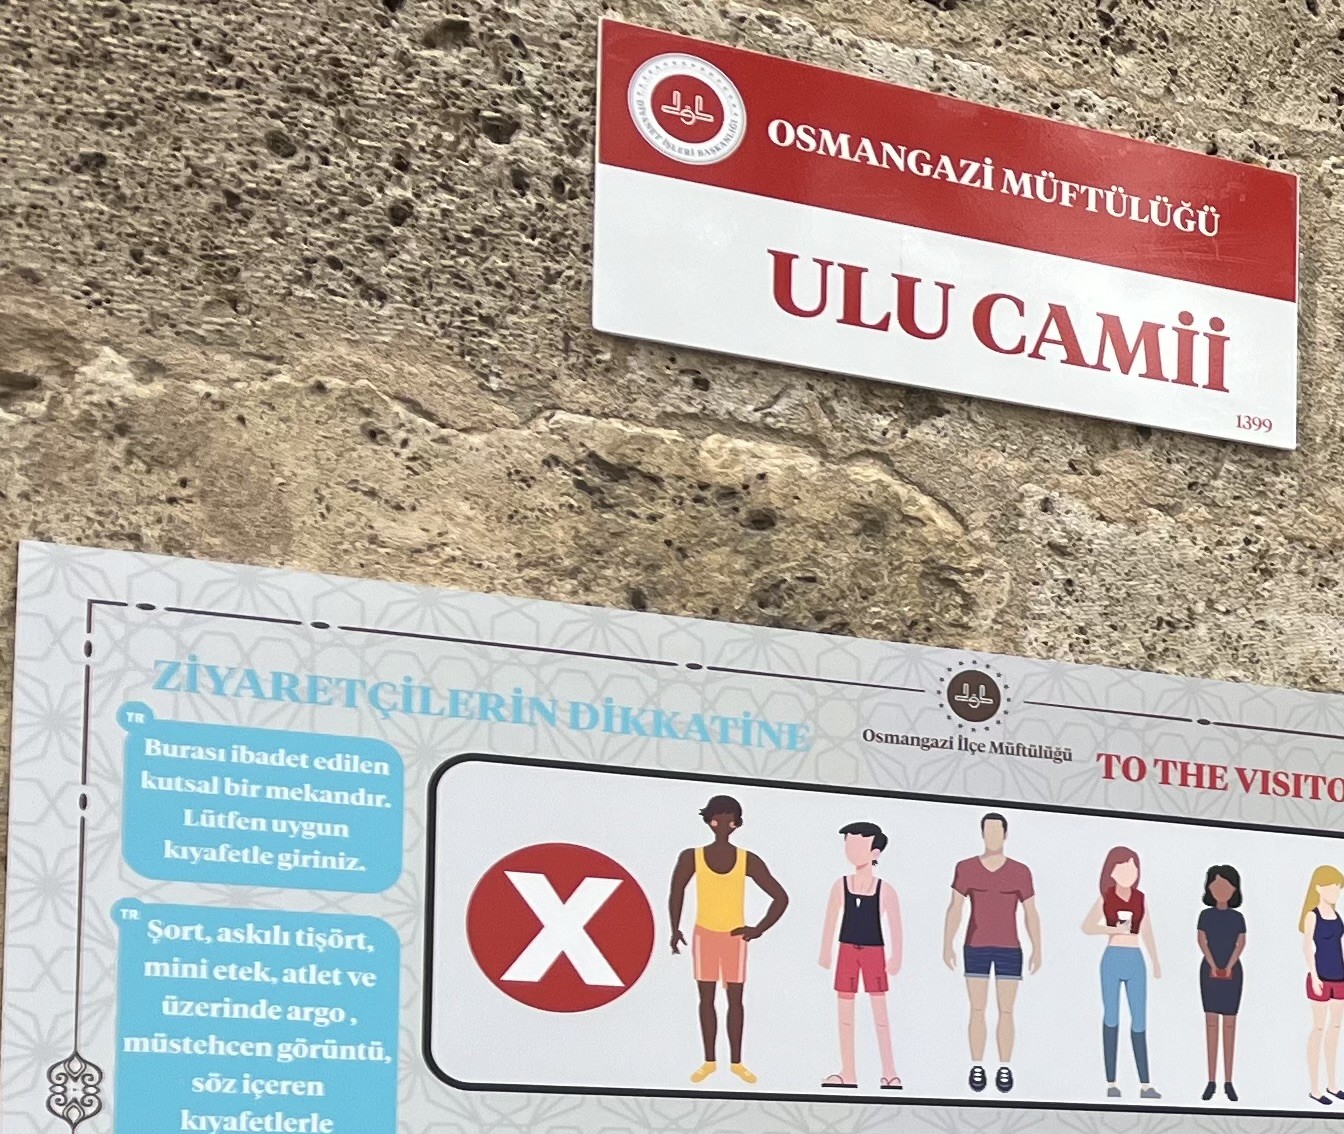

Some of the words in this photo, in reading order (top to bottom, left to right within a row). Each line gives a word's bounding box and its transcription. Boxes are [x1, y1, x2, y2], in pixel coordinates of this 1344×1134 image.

[767, 119, 994, 191] OSMANGAZİ
[1001, 168, 1221, 238] MÜFTÜLÜĞÜ
[768, 249, 955, 340] ULU
[1236, 414, 1273, 433] 1399
[152, 654, 557, 728] ZİYARETÇİLERİN
[569, 697, 812, 752] DİKKATİNE
[145, 738, 226, 762] Burası
[231, 745, 309, 768] ibadet
[314, 753, 389, 775] edilen
[862, 728, 953, 751] Osmangazi
[958, 734, 985, 755] İlçe
[988, 741, 1072, 764] Müftülüğü
[1096, 752, 1147, 782] TO
[1153, 758, 1229, 791] THE
[141, 770, 219, 794] kutsal
[224, 777, 261, 797] bir
[266, 783, 390, 808] mekandır.
[184, 809, 267, 831] Lütfen
[272, 819, 349, 839] uygun
[164, 839, 274, 865] kıyafetle
[277, 849, 365, 871] giriniz.
[147, 919, 212, 944] Şort,
[217, 923, 290, 946] askılı
[295, 927, 373, 952] tişört,
[144, 957, 208, 979] mini
[213, 961, 278, 984] etek,
[282, 964, 341, 985] atlet
[347, 971, 376, 987] ve
[162, 995, 282, 1020] üzerinde
[287, 1005, 345, 1027] argo
[123, 1033, 272, 1056] müstehcen
[277, 1038, 391, 1063] görüntü,
[192, 1073, 236, 1093] söz
[242, 1073, 324, 1099] içeren
[181, 1109, 333, 1134] kıyafetlerle
